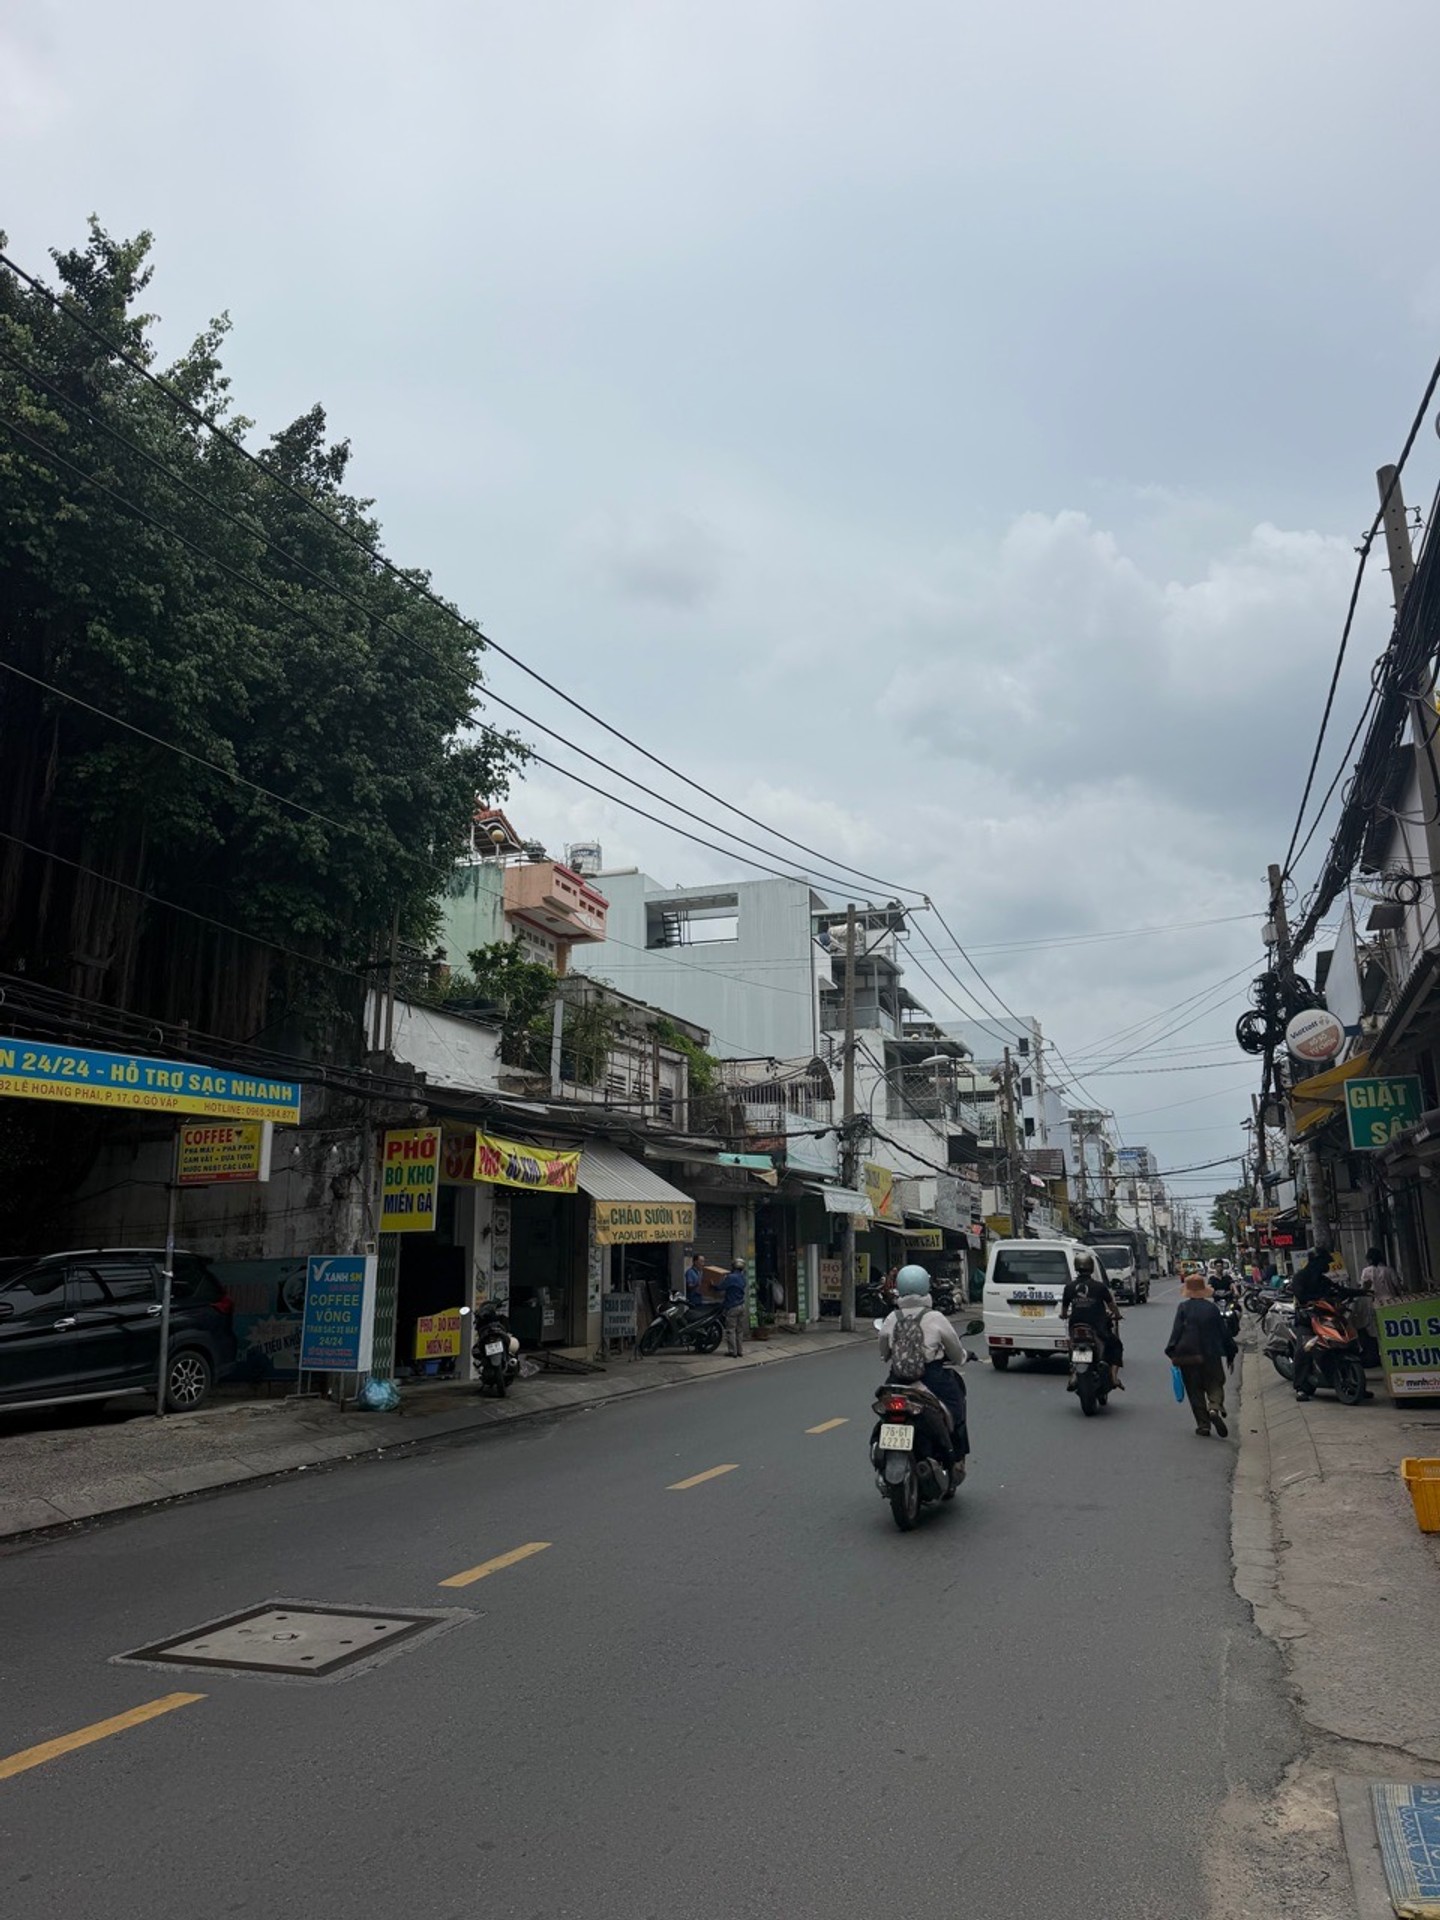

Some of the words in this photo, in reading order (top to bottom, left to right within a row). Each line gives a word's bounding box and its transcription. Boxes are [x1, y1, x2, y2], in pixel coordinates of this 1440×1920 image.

[21, 1052, 90, 1077] 24/24
[110, 1060, 140, 1084] HỖ
[145, 1068, 184, 1092] TRỢ
[188, 1074, 226, 1096] SẠC
[231, 1079, 292, 1101] NHANH
[1350, 1081, 1407, 1111] GIẶT
[185, 1128, 233, 1145] COFFEE
[387, 1133, 437, 1160] PHỞ
[385, 1161, 403, 1185] BÒ
[407, 1164, 435, 1185] KHO
[384, 1187, 413, 1213] MIẾN
[417, 1188, 432, 1212] GÀ
[610, 1205, 641, 1225] CHÁO
[644, 1206, 674, 1225] SƯỜN
[612, 1230, 648, 1240] YAOURT
[324, 1272, 348, 1282] XANH
[310, 1294, 360, 1306] COFFEE
